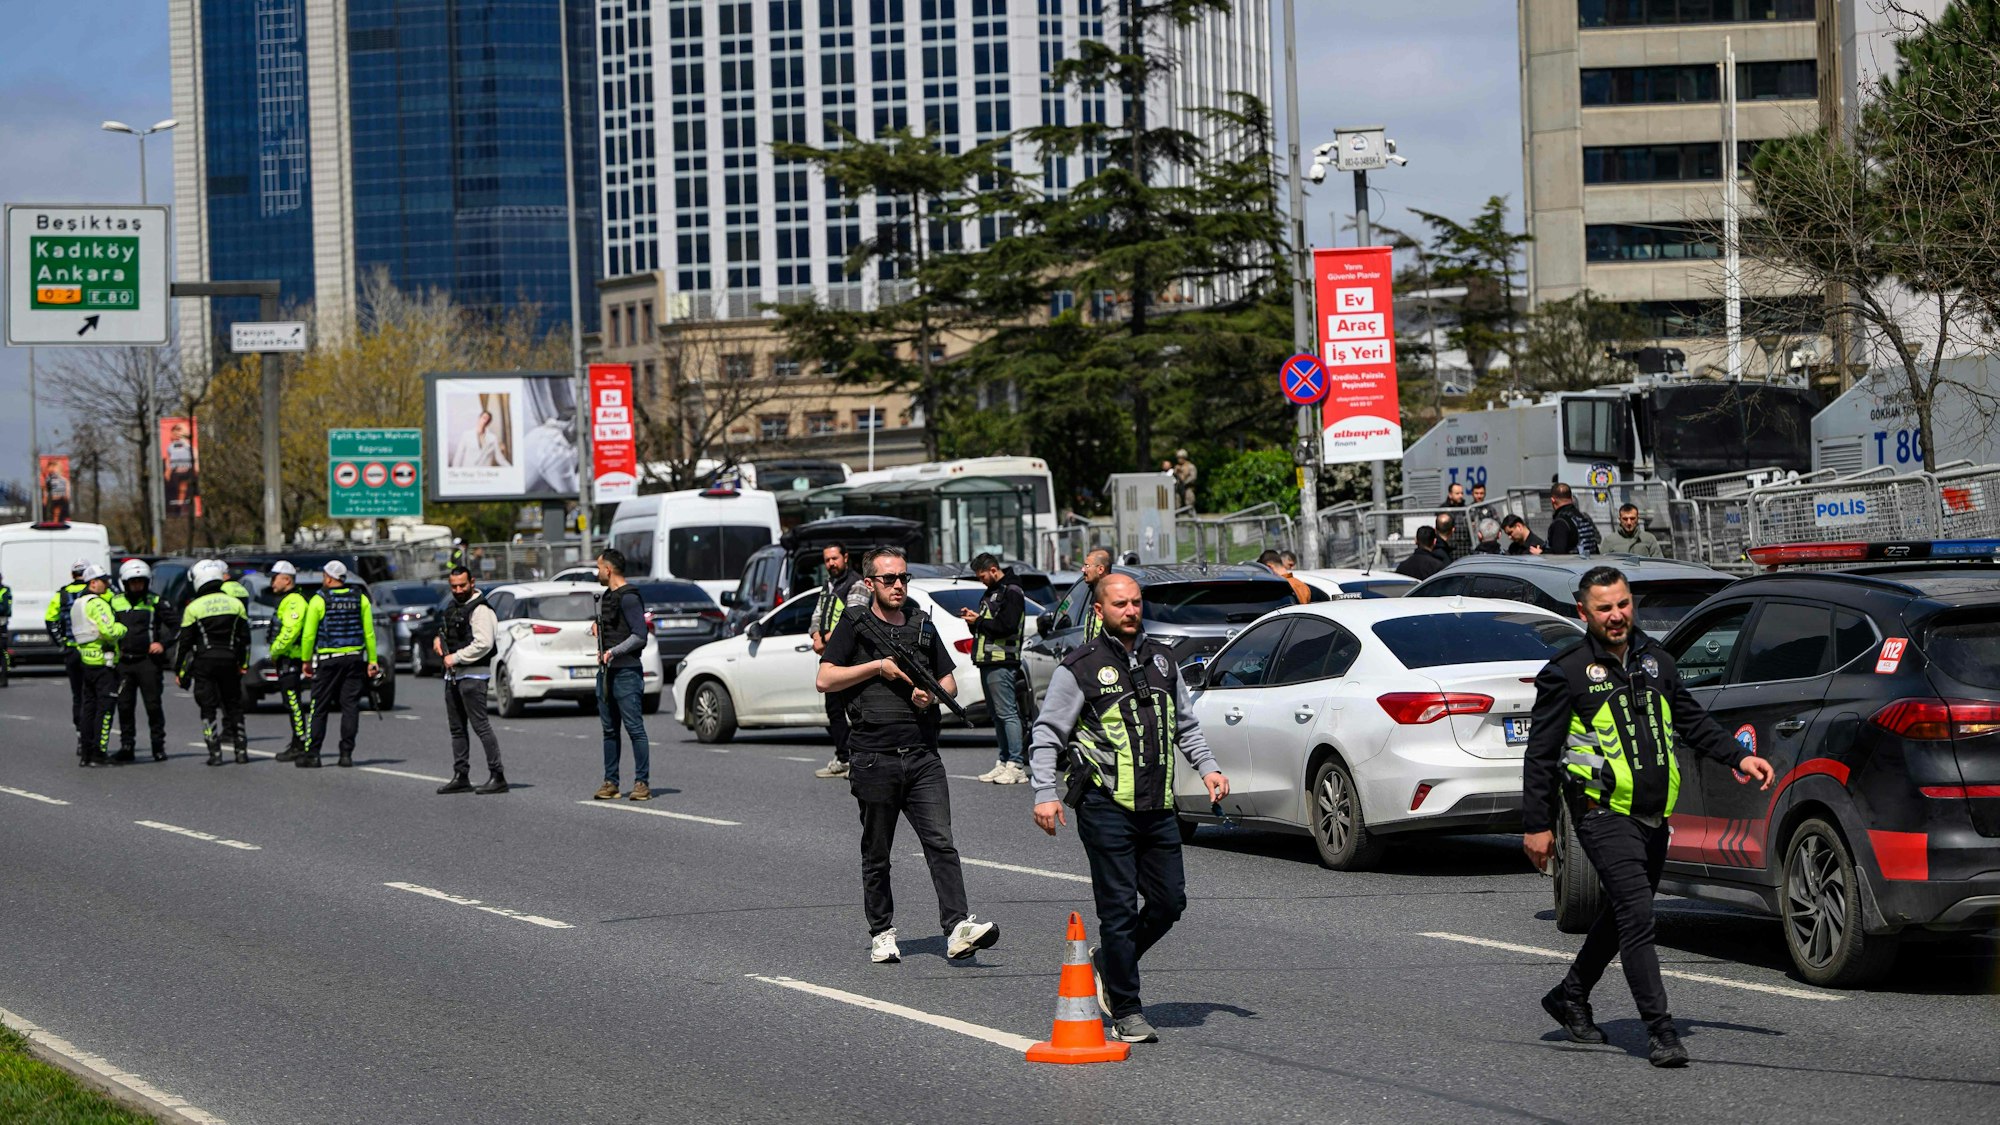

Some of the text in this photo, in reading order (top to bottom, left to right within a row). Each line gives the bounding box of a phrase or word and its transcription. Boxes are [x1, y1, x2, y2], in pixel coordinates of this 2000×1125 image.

[37, 214, 142, 232] Beşiktaş
[36, 241, 135, 263] Kadıköy
[37, 264, 125, 281] Ankara
[1344, 293, 1364, 307] Ev
[1337, 319, 1376, 334] Araç
[1332, 344, 1383, 363] İş Yeri
[1334, 428, 1390, 440] albayrak
[1874, 431, 1887, 465] T
[1816, 499, 1866, 518] POLİS
[1884, 641, 1903, 659] 112
[1100, 685, 1123, 695] POLİS
[1589, 682, 1614, 693] POLİS
